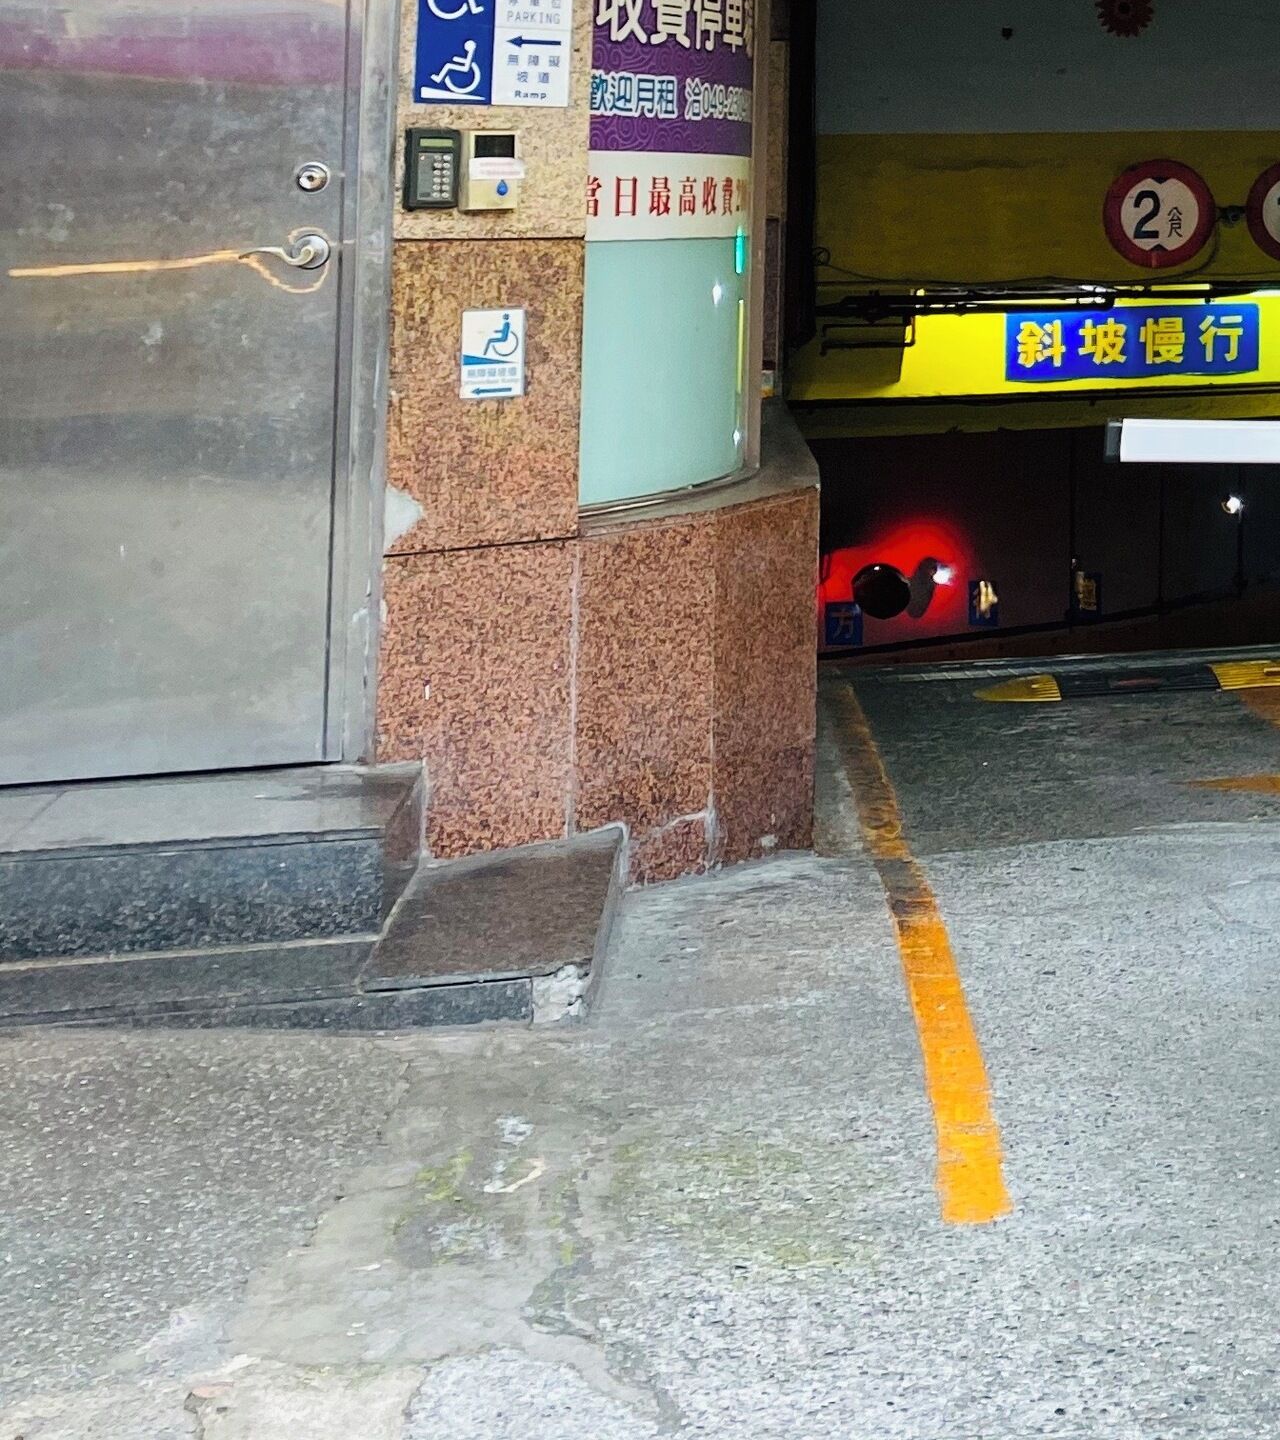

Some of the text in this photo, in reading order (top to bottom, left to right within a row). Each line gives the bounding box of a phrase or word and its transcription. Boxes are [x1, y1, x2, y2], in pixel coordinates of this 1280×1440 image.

[507, 10, 561, 24] PARKING
[514, 90, 547, 99] Ramp
[1133, 190, 1183, 239] 2 公尺
[1016, 315, 1243, 368] 斜坡慢行
